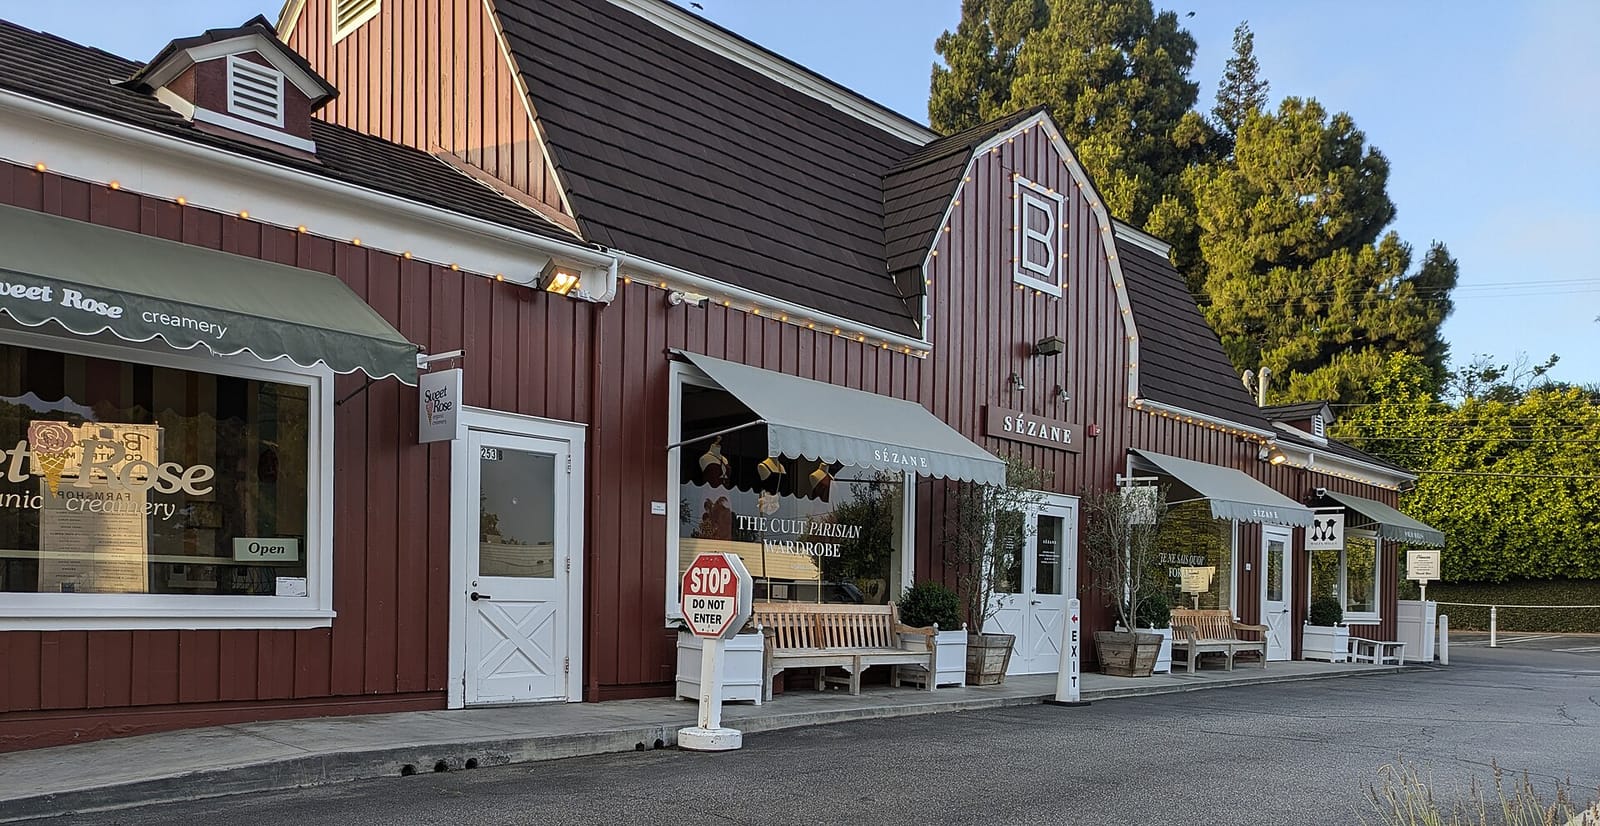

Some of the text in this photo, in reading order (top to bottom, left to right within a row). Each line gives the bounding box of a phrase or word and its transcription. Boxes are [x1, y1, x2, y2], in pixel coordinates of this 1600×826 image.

[1022, 193, 1055, 277] B
[60, 288, 123, 319] Rose
[142, 311, 227, 339] creamery
[425, 385, 447, 403] Sweet
[433, 400, 452, 413] Rose
[1003, 414, 1072, 444] SÉZANE
[73, 439, 215, 496] Rose
[874, 448, 928, 468] SÉZANE
[0, 490, 175, 520] nic creamery
[736, 515, 862, 539] THE CULT PARISIAN
[1310, 519, 1337, 541] M
[248, 542, 285, 556] Open
[763, 539, 840, 557] WARDROBE
[690, 566, 731, 594] STOP
[692, 599, 725, 610] DO NOT
[693, 613, 722, 625] ENTER
